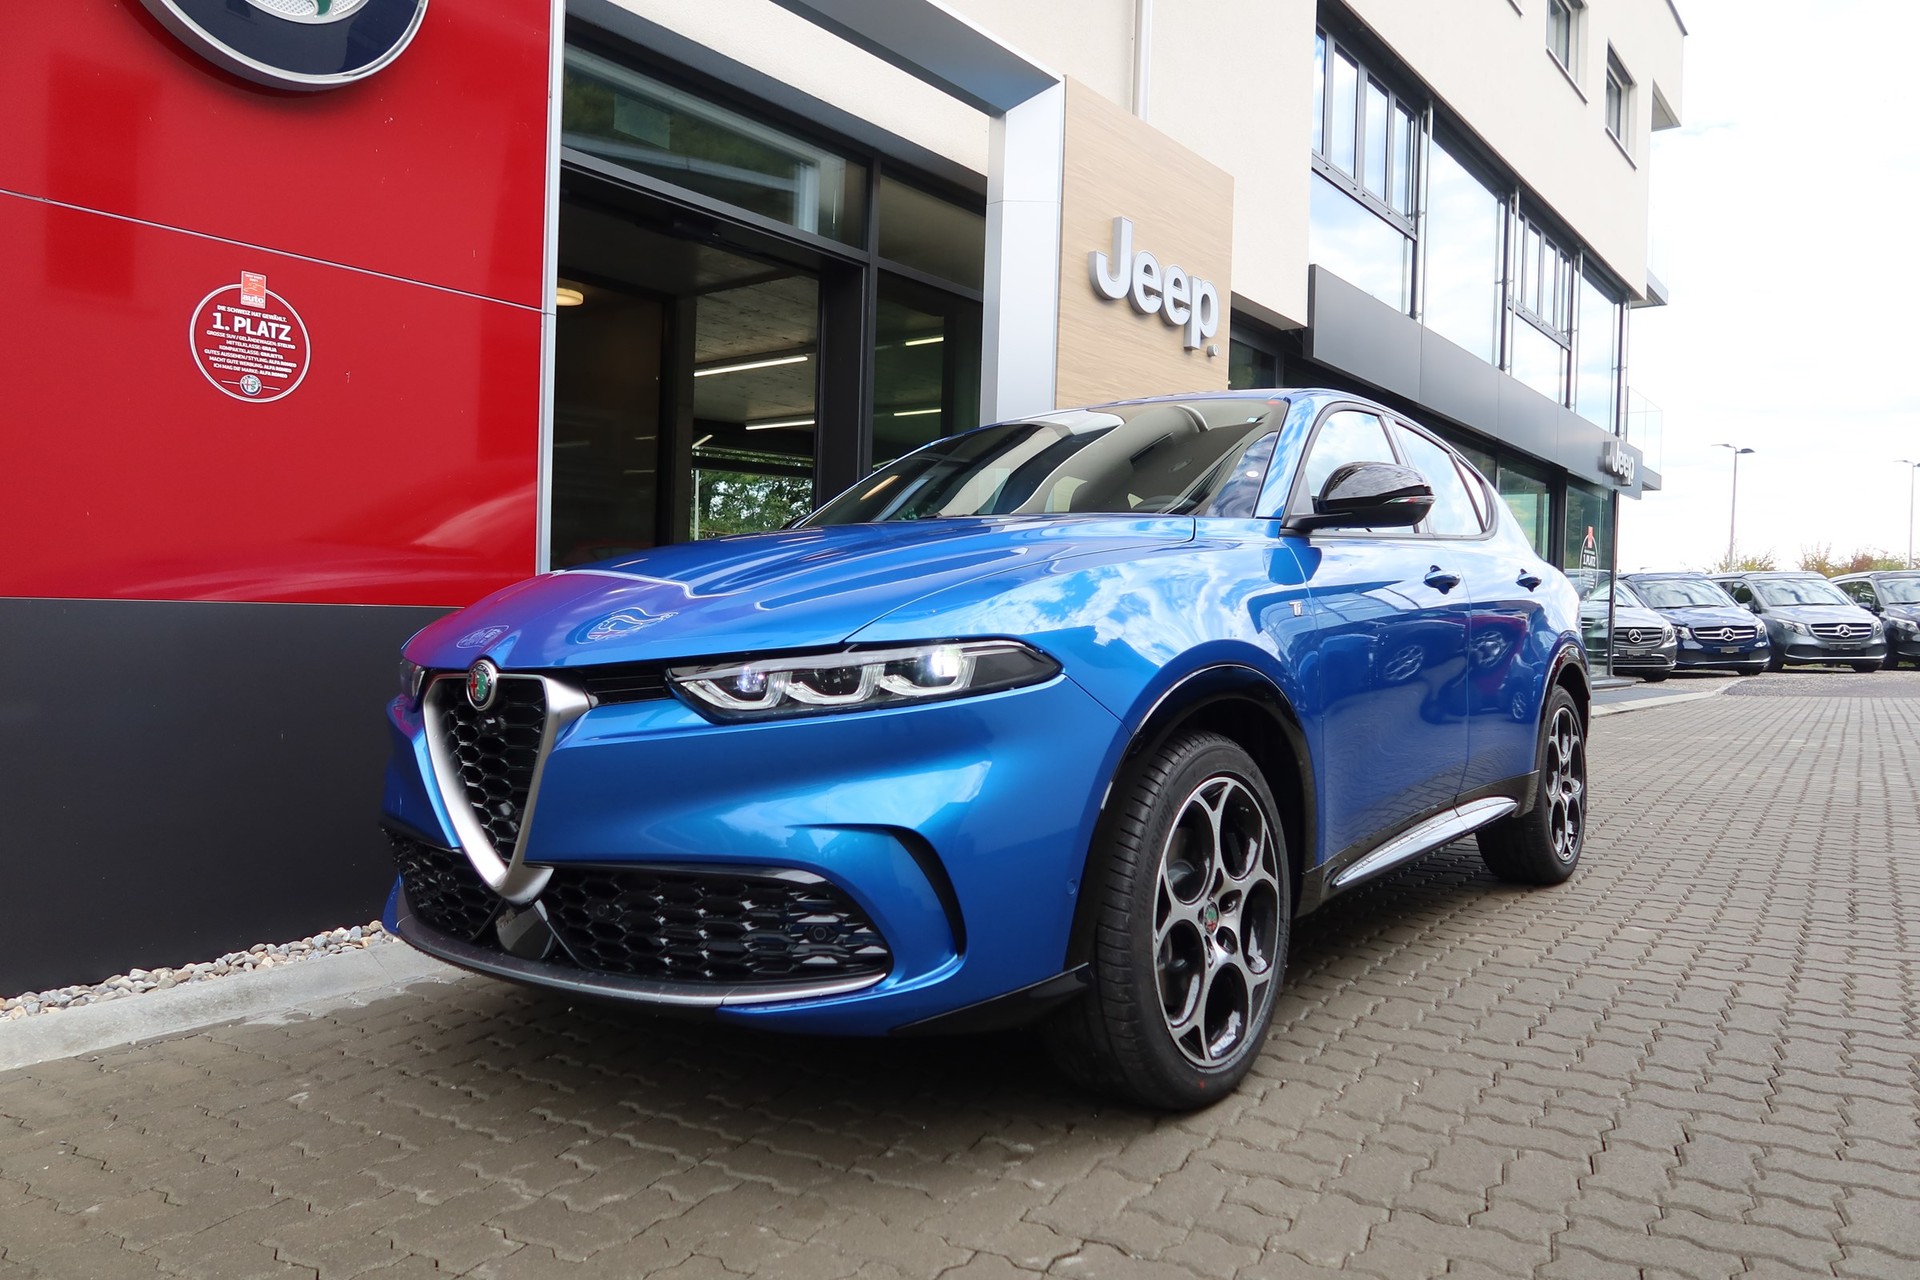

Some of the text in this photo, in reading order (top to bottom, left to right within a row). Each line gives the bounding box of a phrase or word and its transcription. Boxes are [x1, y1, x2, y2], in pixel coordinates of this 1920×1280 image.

[1088, 216, 1219, 351] Jeep
[213, 312, 291, 342] 1. PLATZ
[1608, 441, 1634, 486] Jeep
